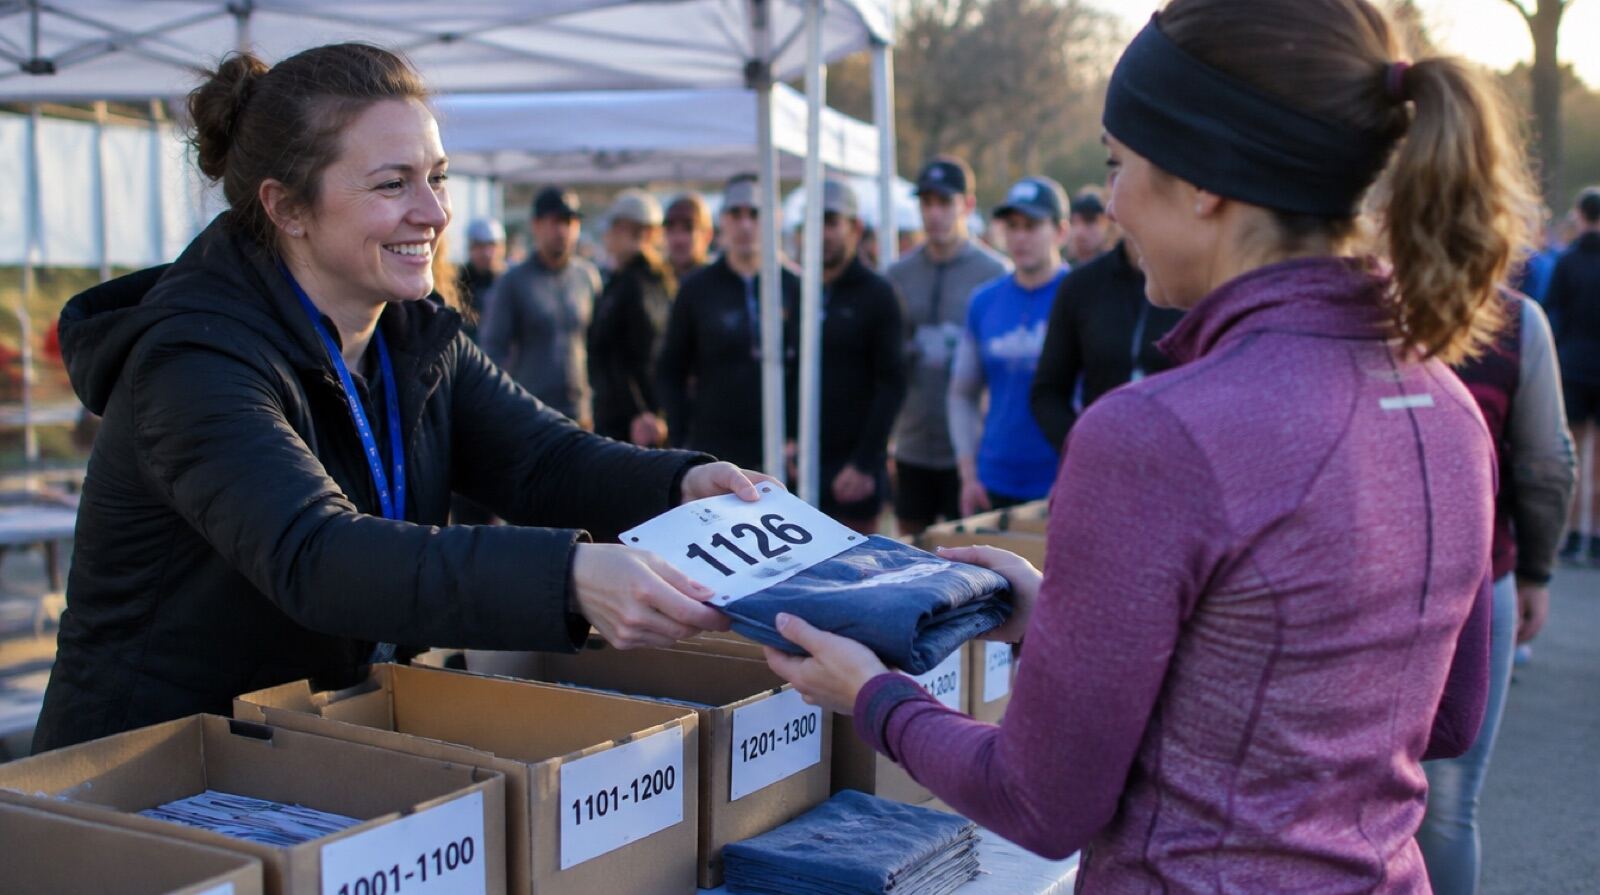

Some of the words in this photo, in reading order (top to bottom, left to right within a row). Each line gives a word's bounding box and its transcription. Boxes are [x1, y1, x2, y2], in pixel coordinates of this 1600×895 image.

[686, 513, 813, 577] 1126
[741, 712, 816, 763] 1201-1300
[572, 765, 675, 826] 1101-1200
